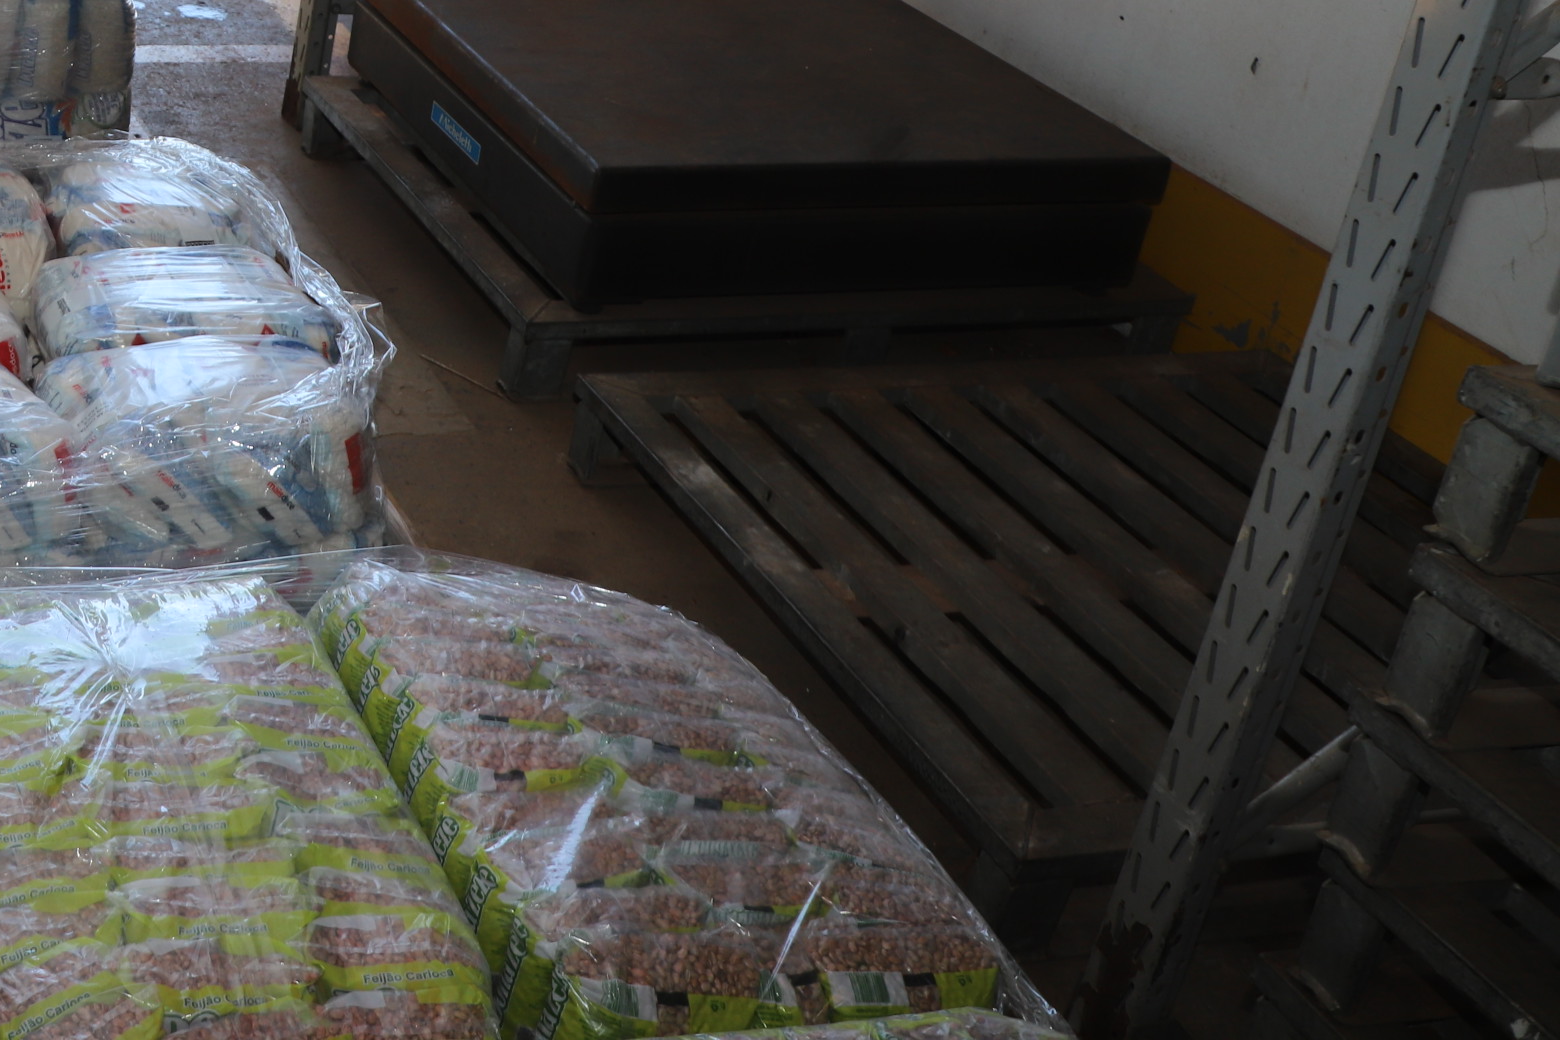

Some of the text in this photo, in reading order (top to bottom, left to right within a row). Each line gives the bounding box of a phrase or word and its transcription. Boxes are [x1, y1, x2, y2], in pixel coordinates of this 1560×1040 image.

[286, 738, 321, 750] Feijão
[142, 820, 227, 835] Feijão Carioca
[350, 857, 431, 875] Feijão Carioca
[29, 884, 76, 899] Carioca
[178, 923, 268, 937] Feijão Carioca
[362, 968, 456, 986] Feijão Carioca
[45, 991, 91, 1019] Carioca
[183, 995, 223, 1009] Feijão
